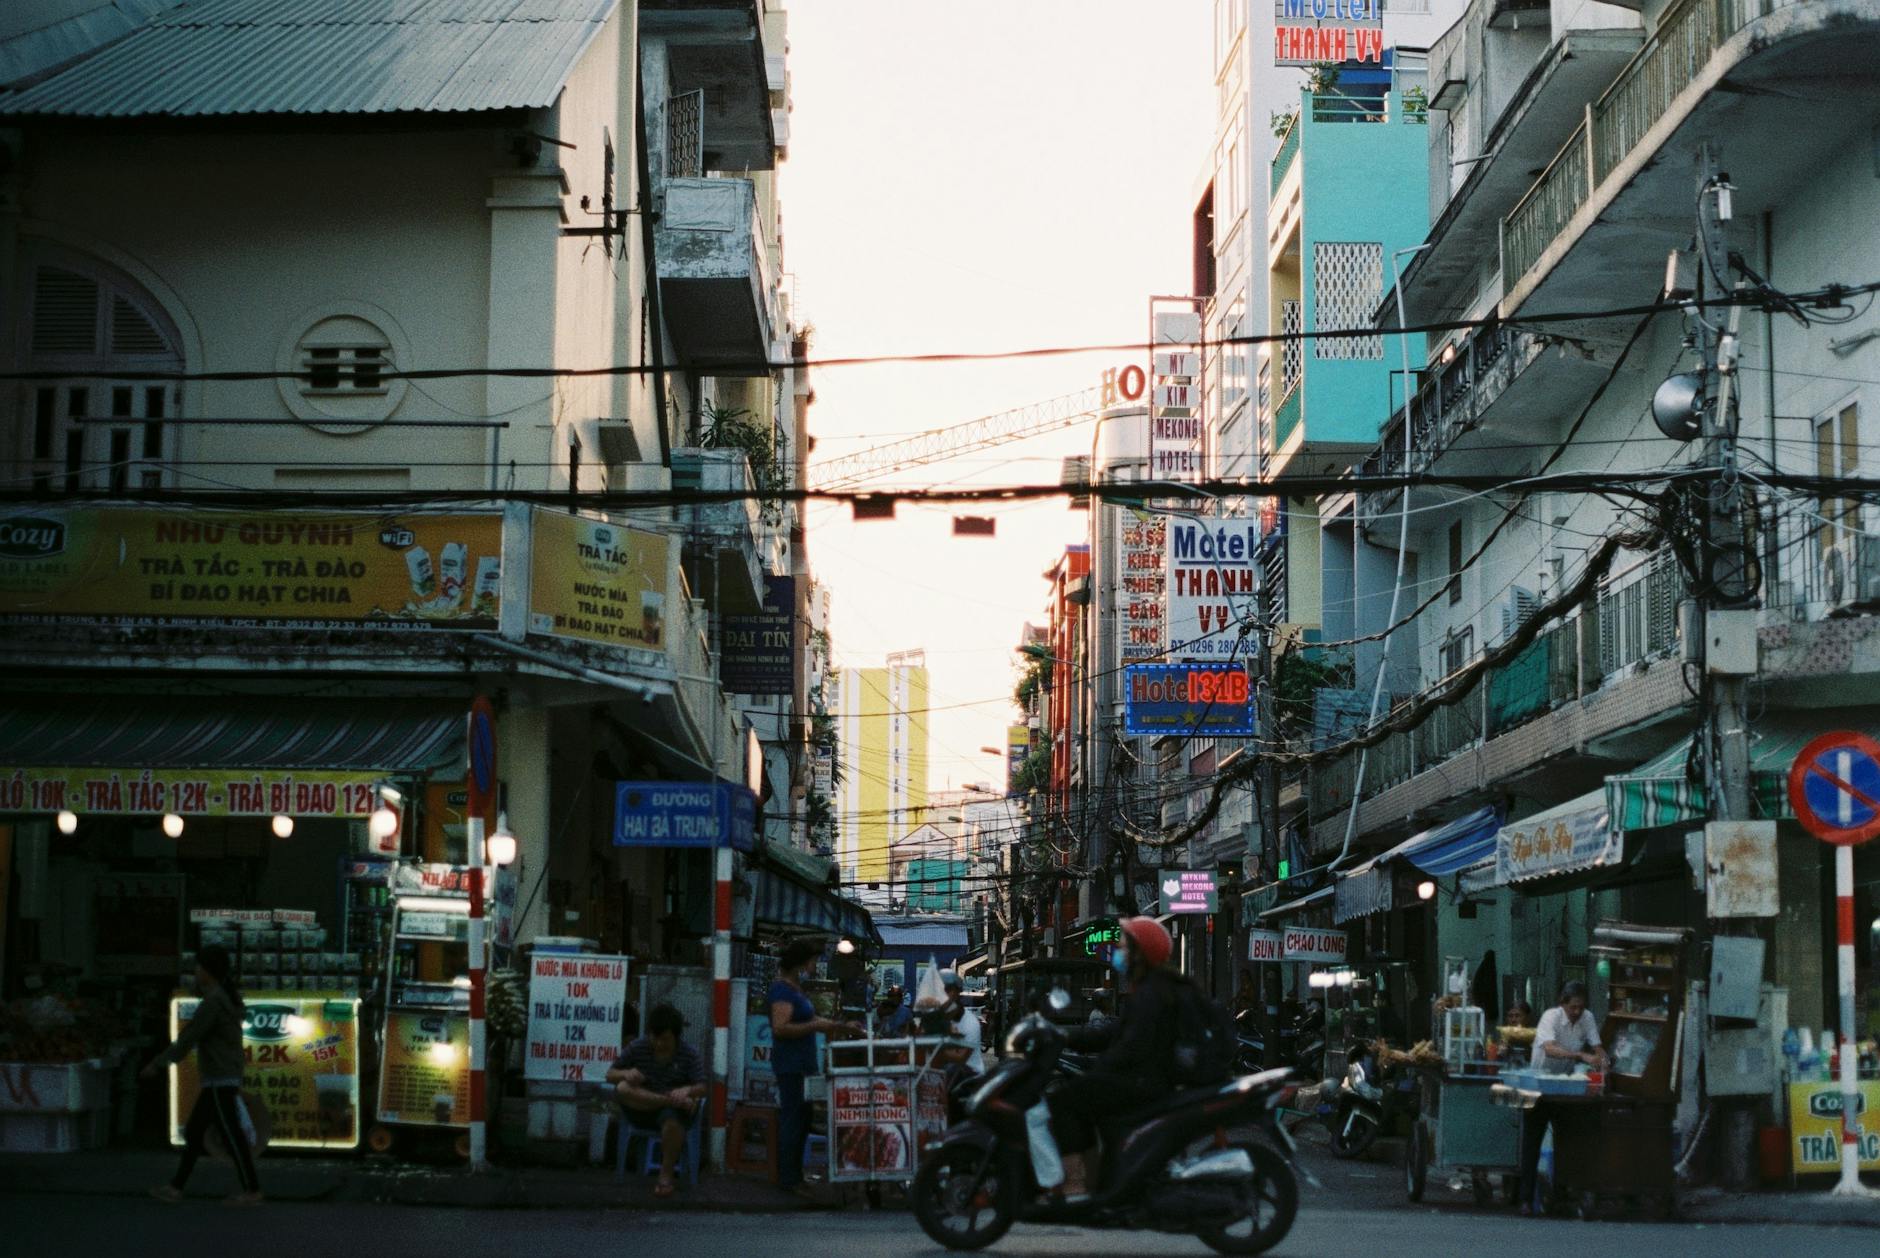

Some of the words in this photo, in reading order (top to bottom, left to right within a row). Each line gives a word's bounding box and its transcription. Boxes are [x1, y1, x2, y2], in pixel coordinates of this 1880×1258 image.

[1276, 27, 1347, 61] THANH
[1355, 29, 1383, 62] VY
[1169, 354, 1185, 375] MY
[1167, 386, 1188, 406] KIM
[1155, 418, 1198, 440] MEKONG
[1159, 450, 1194, 472] HOTEL
[0, 523, 57, 551] Cozy
[1174, 525, 1254, 559] Motel
[140, 554, 186, 576] TRÀ
[193, 552, 239, 576] TẮC
[262, 556, 308, 577] TRÀ
[316, 557, 366, 577] ĐÀO
[151, 580, 173, 600] BÍ
[180, 583, 230, 600] ĐAO
[239, 585, 287, 607] HẠT
[293, 585, 353, 604] CHIA
[1175, 569, 1253, 597] THANH
[1198, 605, 1229, 633] VY
[726, 631, 757, 651] ĐẠI
[763, 625, 790, 648] TÍN
[1131, 671, 1199, 705] Hotel
[1200, 671, 1249, 705] 31B
[31, 780, 66, 810] 10K
[86, 775, 122, 811] TRÀ
[128, 771, 164, 811] TẮC
[171, 782, 208, 812] 12K
[228, 777, 263, 813] TRÀ
[271, 776, 290, 813] BÍ
[296, 783, 336, 814] ĐAO
[652, 790, 711, 807] ĐƯỜNG
[624, 815, 648, 838] HAI
[651, 811, 671, 838] BÀ
[1181, 882, 1214, 891] MEKONG
[1182, 892, 1206, 900] HOTEL
[1254, 935, 1274, 959] BÚN
[566, 982, 590, 998] 10K
[565, 1025, 587, 1041] 12K
[562, 1064, 585, 1080] 12K
[1799, 1130, 1838, 1161] TRÀ
